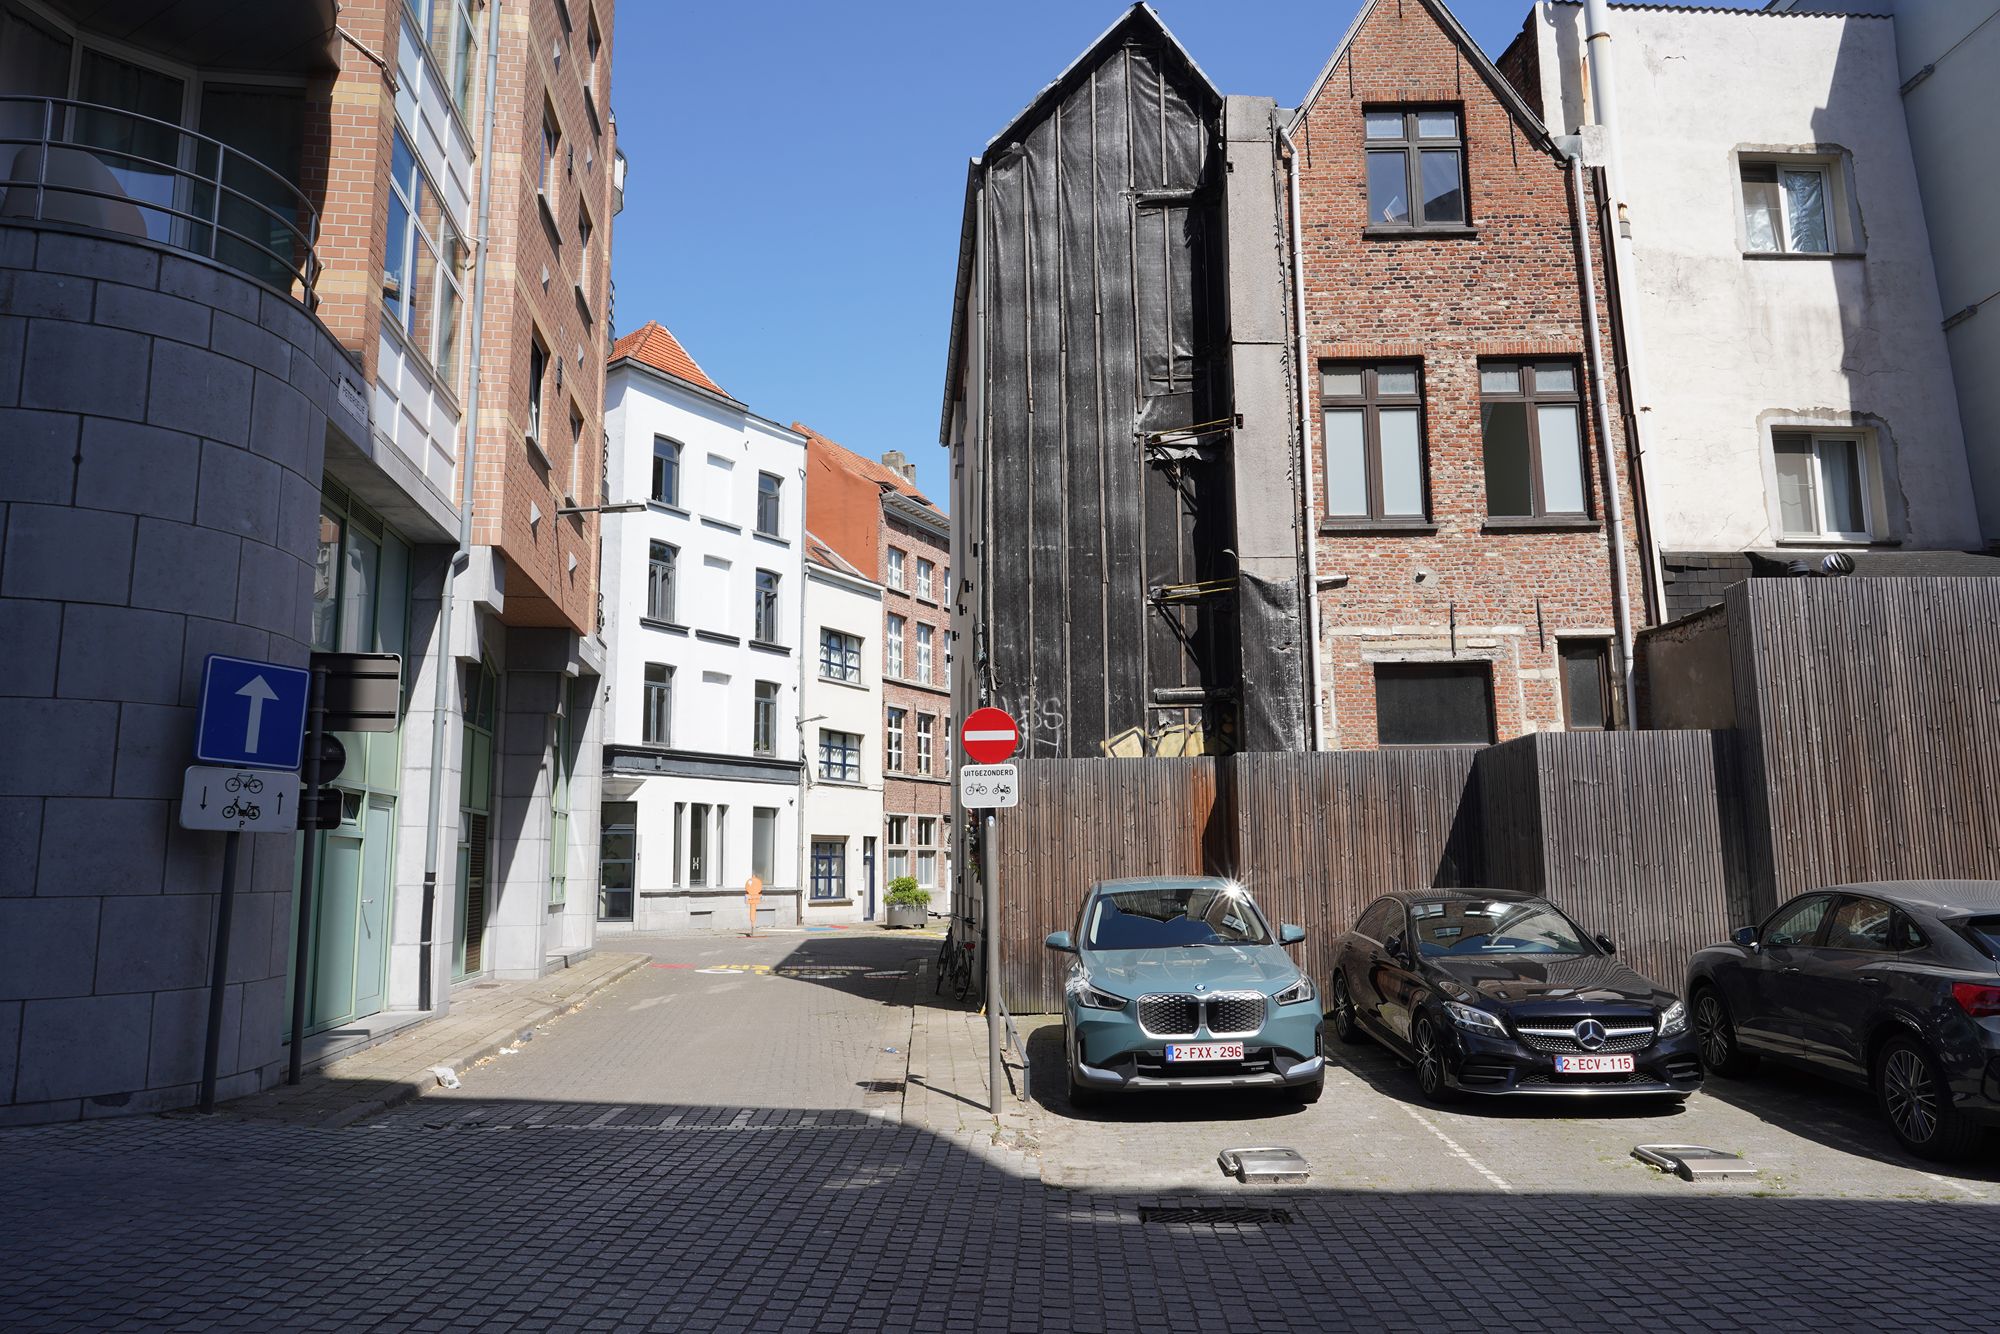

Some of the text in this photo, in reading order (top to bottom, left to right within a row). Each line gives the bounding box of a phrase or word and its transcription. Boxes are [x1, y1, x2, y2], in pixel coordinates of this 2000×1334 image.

[963, 769, 1014, 777] UITGEZONDERD
[1000, 795, 1006, 803] P
[238, 820, 246, 828] P
[1174, 1046, 1242, 1059] 2-FXX-296
[1563, 1058, 1631, 1070] 2-ECV-115
